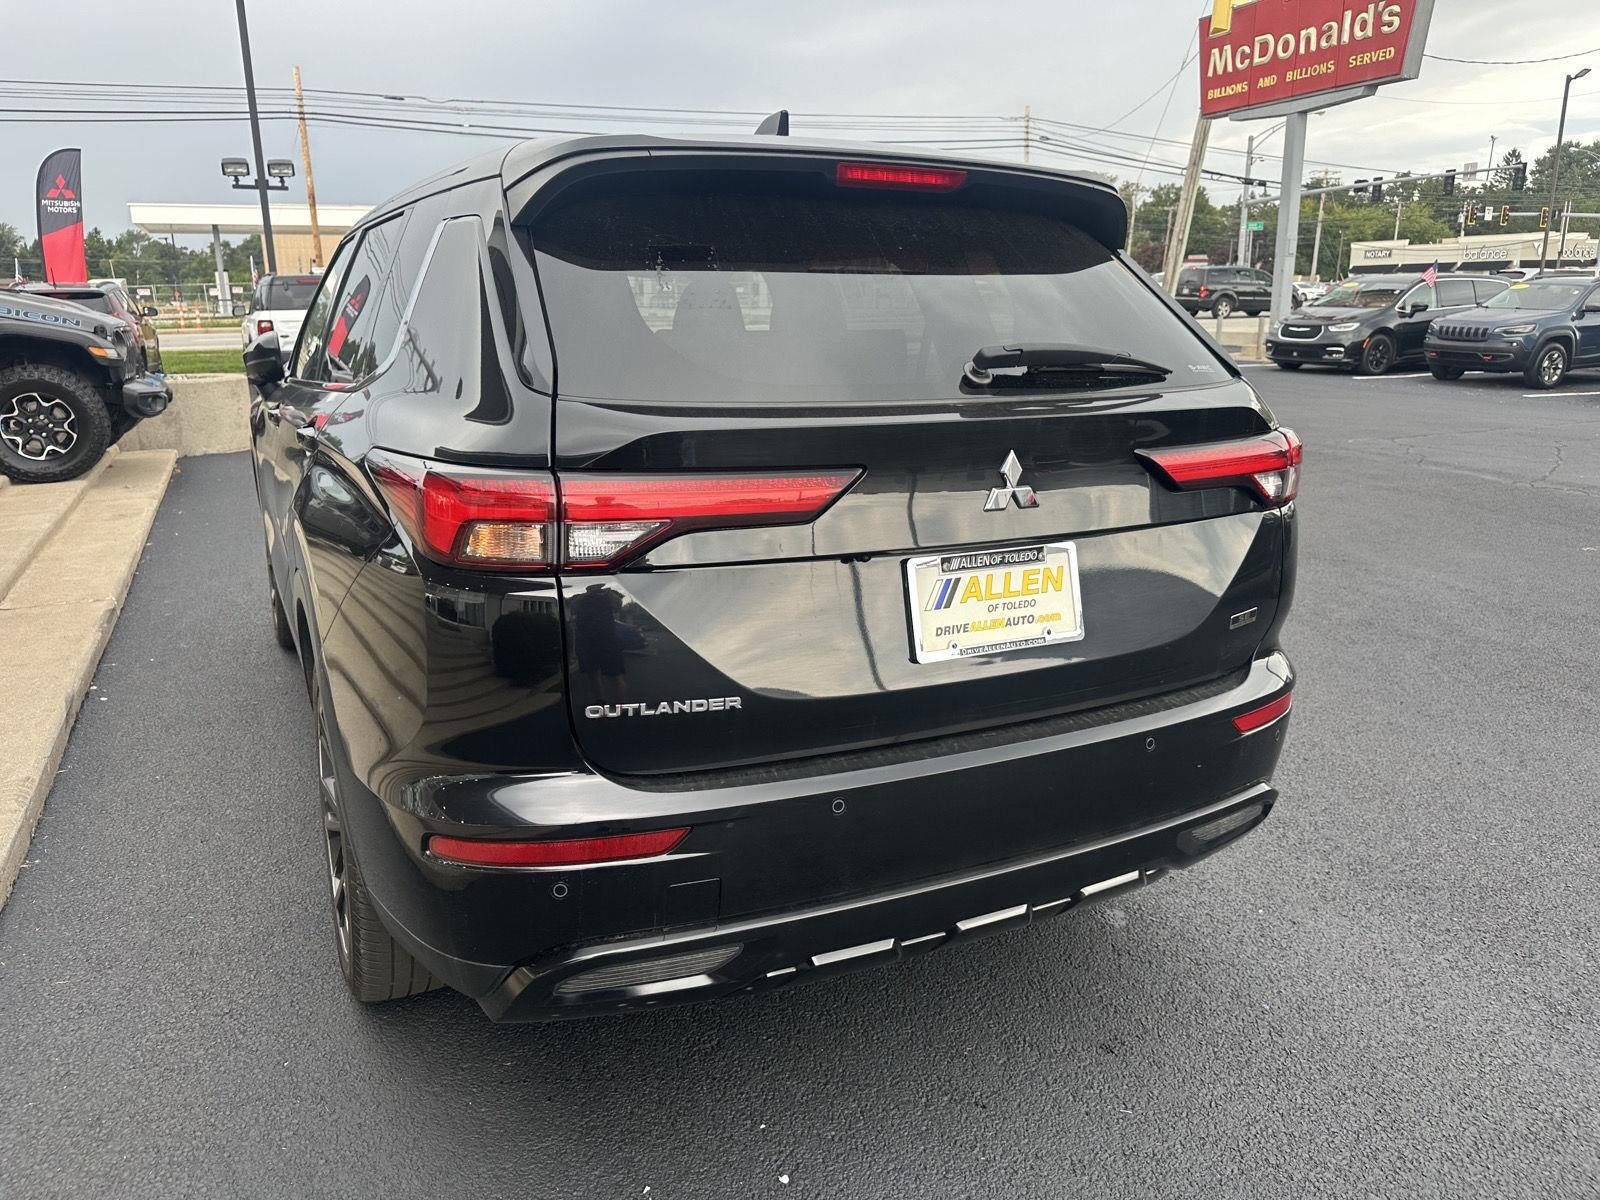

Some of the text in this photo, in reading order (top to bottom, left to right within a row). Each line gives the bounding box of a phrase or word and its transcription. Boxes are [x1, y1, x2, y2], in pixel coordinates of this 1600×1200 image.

[1207, 1, 1401, 78] McDonald's
[1207, 47, 1396, 100] BILLIONS AND BILLIONS SERVED
[47, 206, 78, 214] MOTORS
[1366, 250, 1391, 259] NOTARY
[1463, 243, 1508, 260] balance
[990, 555, 1003, 565] OF
[1004, 549, 1038, 563] TOLEDO
[959, 565, 1065, 604] ALLEN
[987, 598, 1037, 613] OF TOLEDO
[585, 696, 742, 719] OUTLANDER
